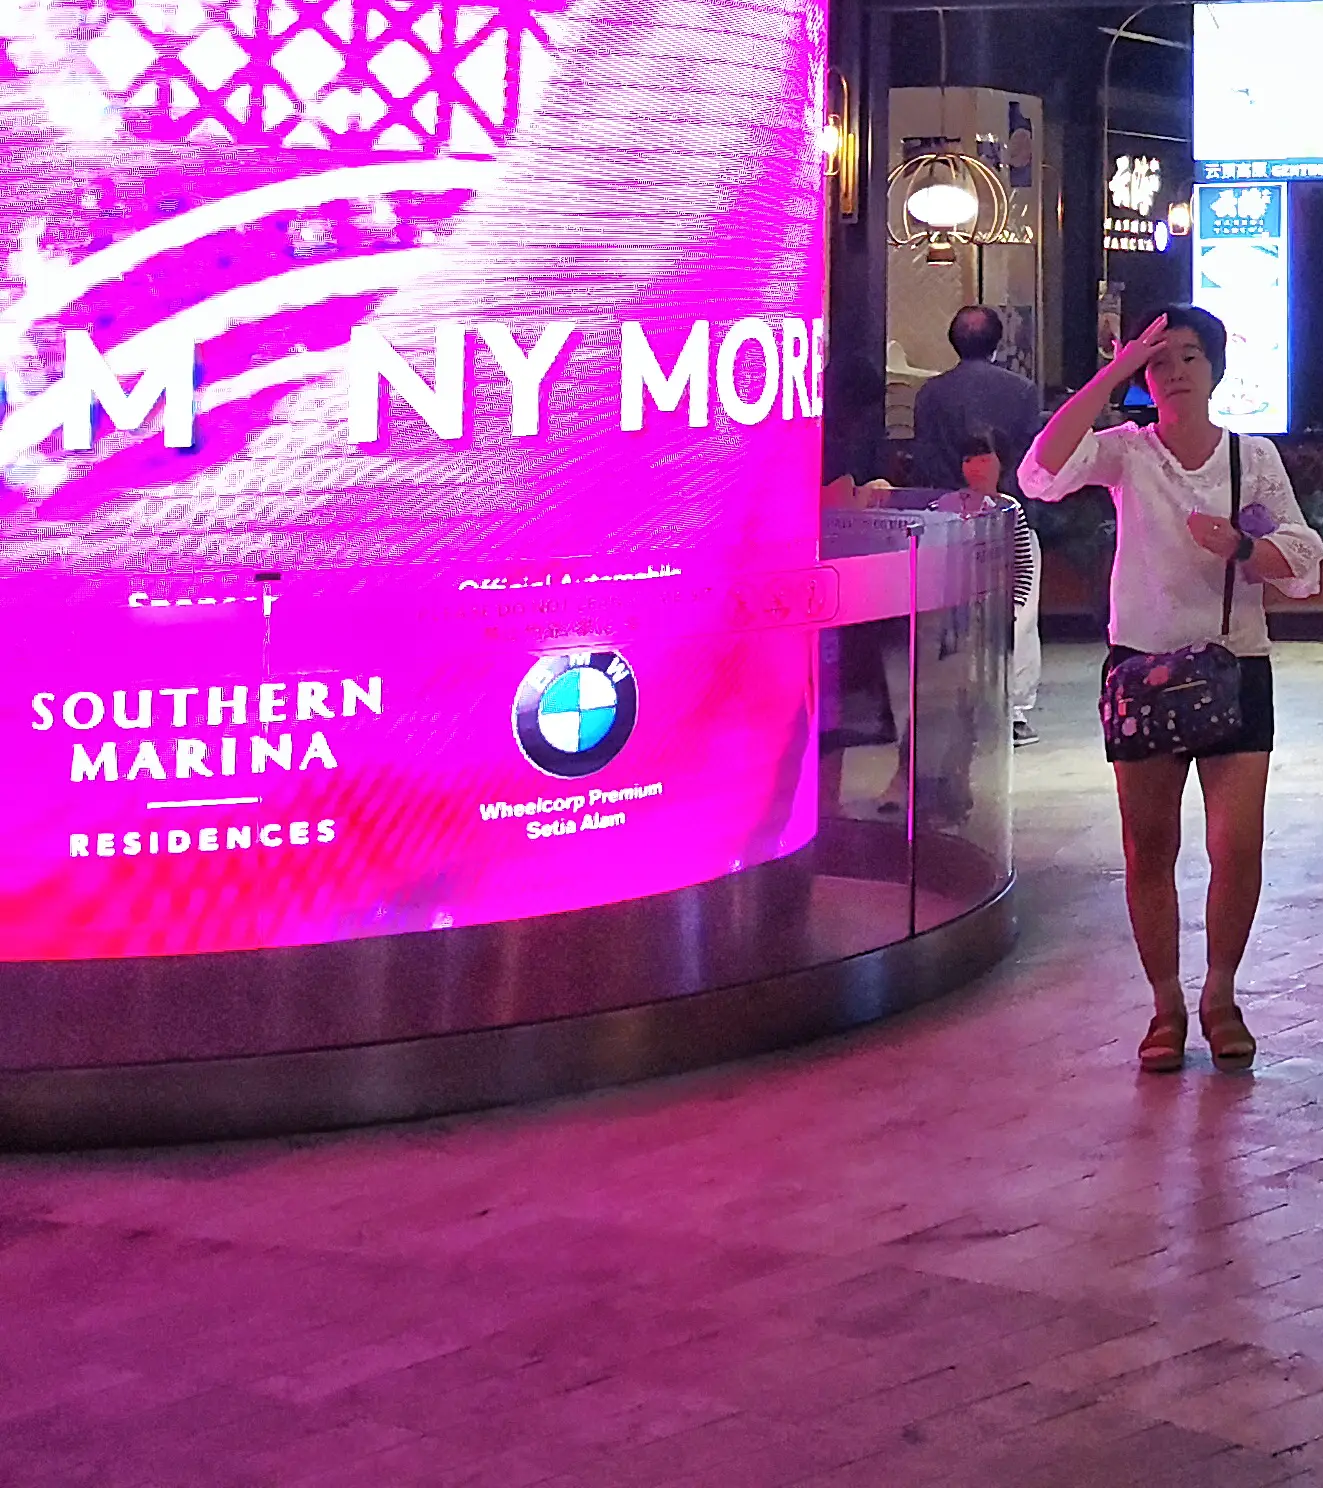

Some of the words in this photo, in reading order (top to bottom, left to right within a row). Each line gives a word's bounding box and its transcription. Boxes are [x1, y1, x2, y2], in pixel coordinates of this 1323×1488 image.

[31, 675, 384, 731] SOUTHERN
[70, 731, 339, 783] MARINA
[479, 794, 586, 822] Wheelcorp
[588, 781, 663, 806] Premium
[69, 818, 336, 858] RESIDENCES
[526, 817, 577, 840] Setia
[580, 811, 626, 832] Alam
